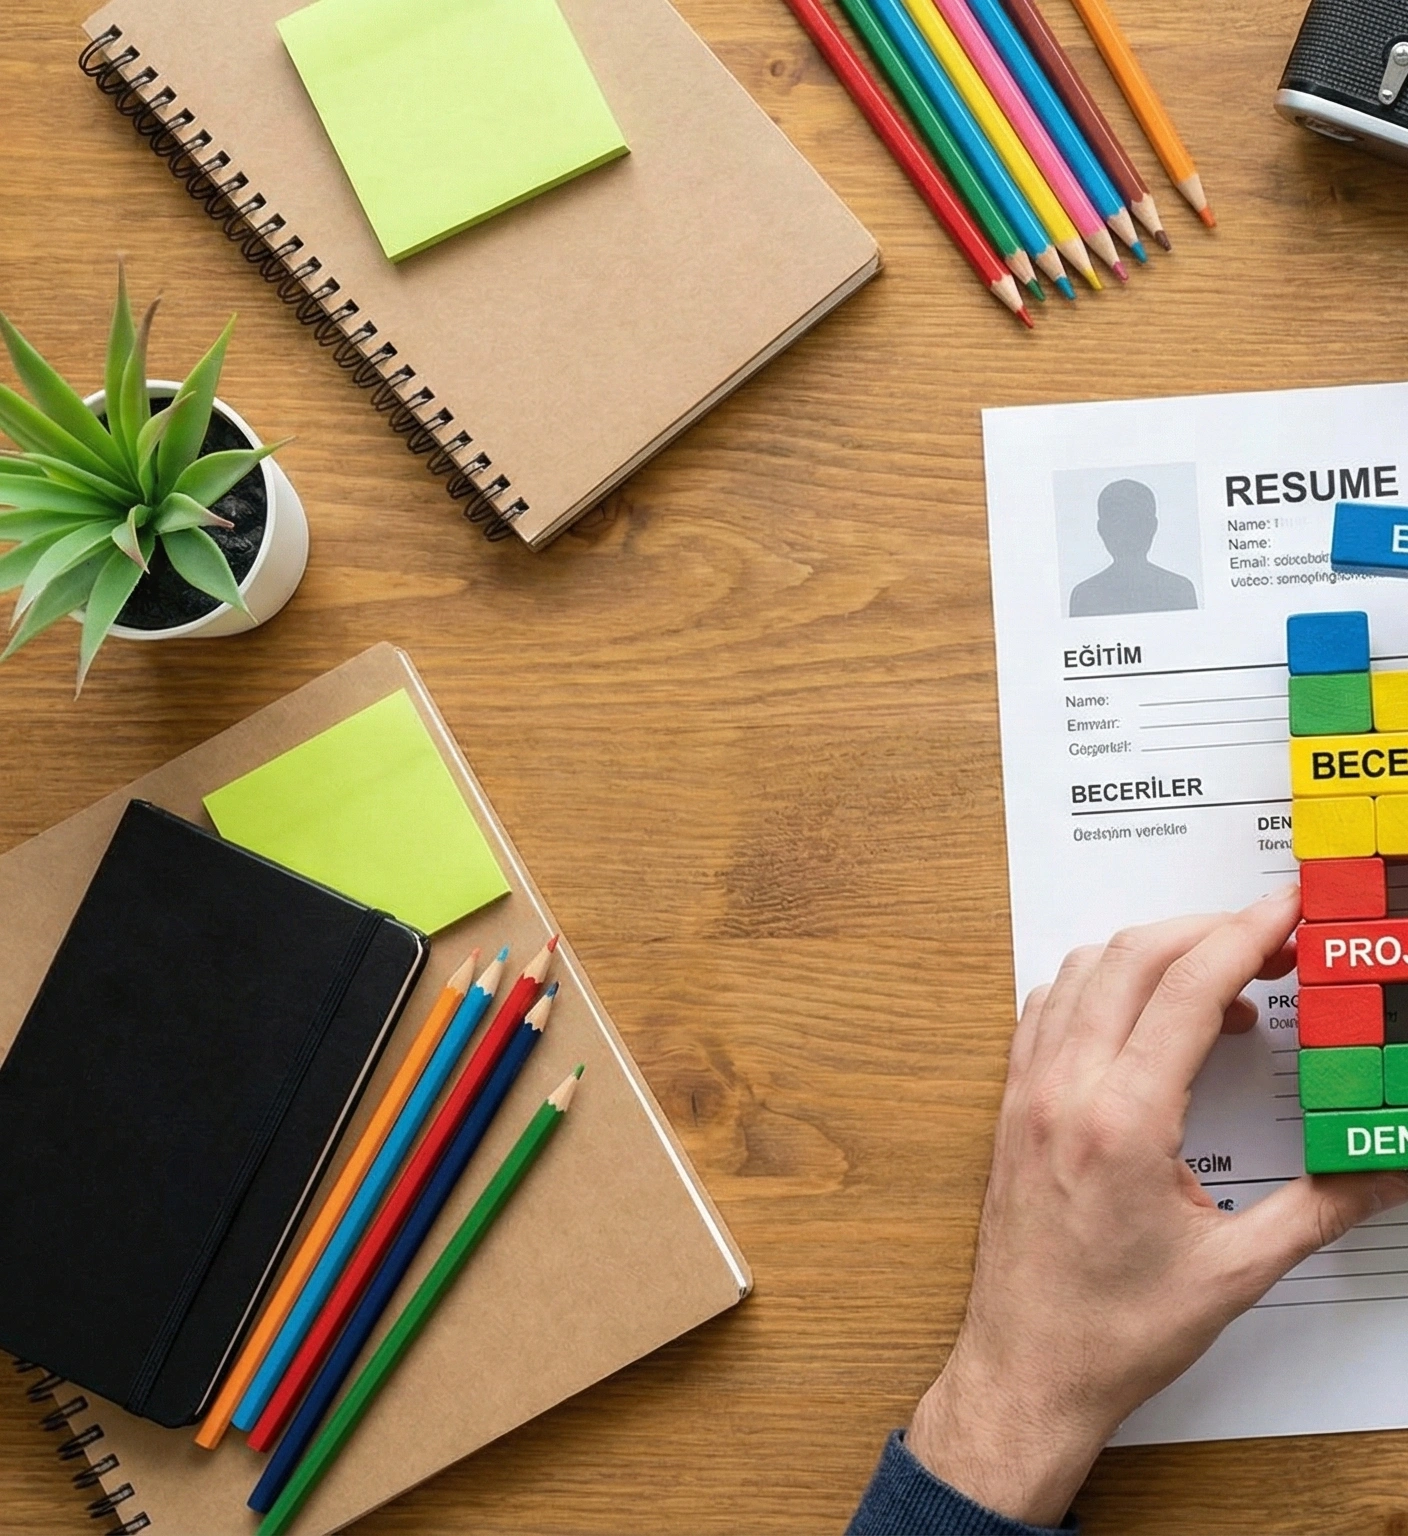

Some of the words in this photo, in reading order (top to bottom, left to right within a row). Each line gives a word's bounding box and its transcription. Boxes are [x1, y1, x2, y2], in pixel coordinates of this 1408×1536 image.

[1225, 465, 1399, 507] RESUME
[1227, 519, 1271, 532] Name:
[1228, 538, 1271, 550] Name:
[1230, 555, 1270, 569] Email:
[1064, 643, 1142, 668] EĞİTİM
[1071, 776, 1203, 803] BECERİLER
